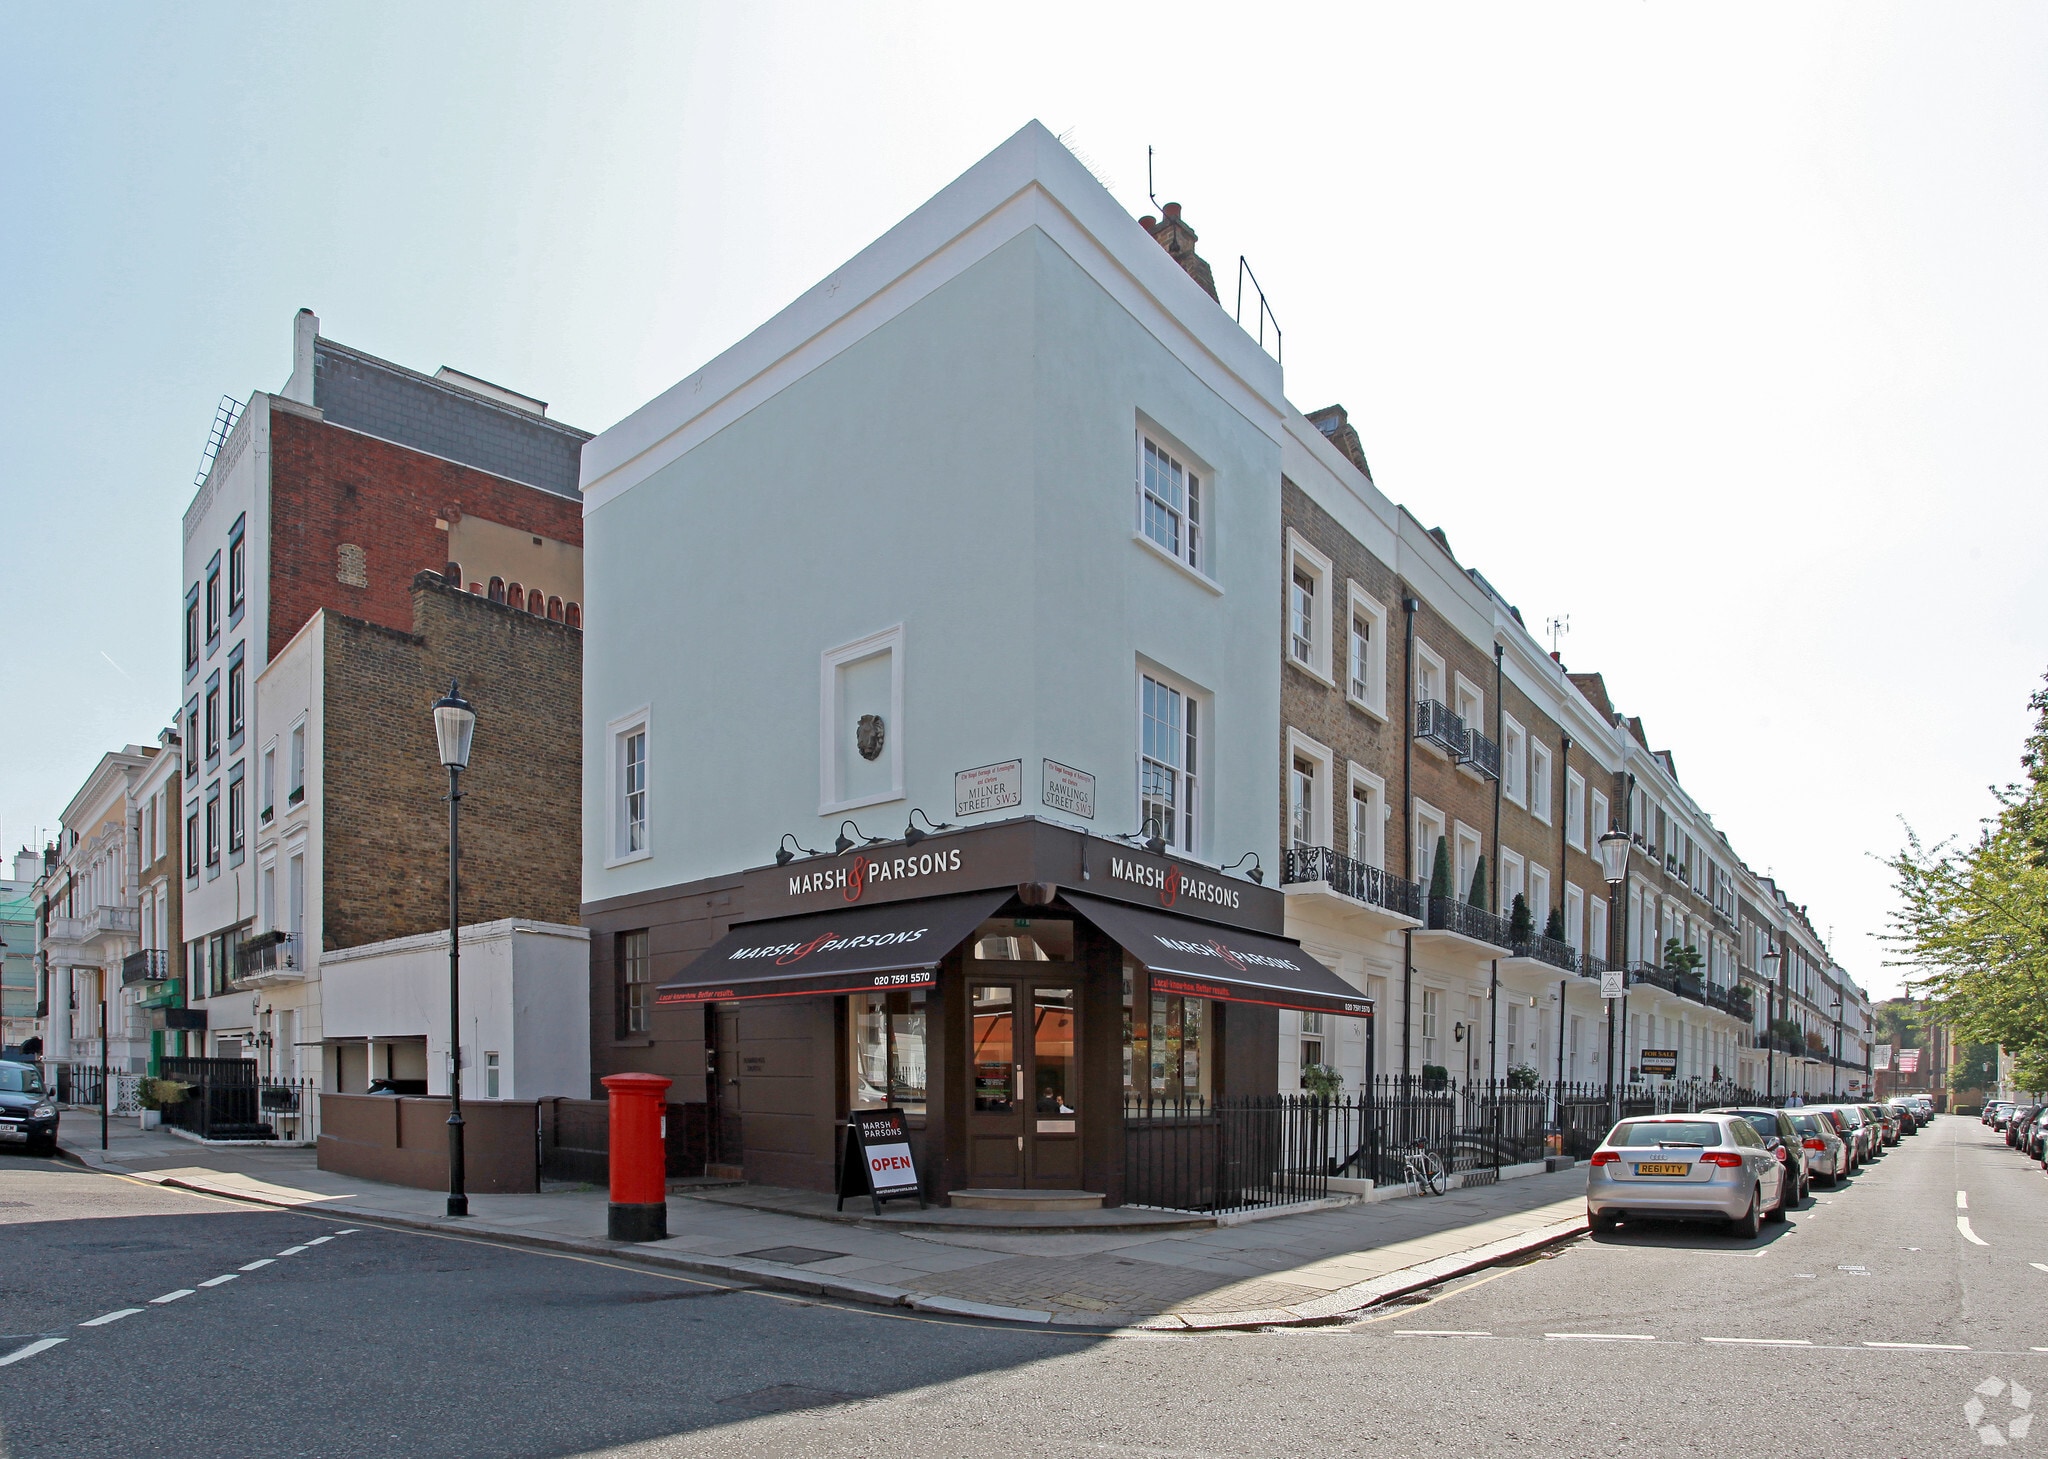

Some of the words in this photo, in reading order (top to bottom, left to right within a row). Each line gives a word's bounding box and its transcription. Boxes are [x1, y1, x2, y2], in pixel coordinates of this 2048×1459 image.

[969, 783, 1006, 799] MILNER
[1050, 780, 1089, 803] RAWLINGS
[789, 868, 847, 896] MARSH
[843, 856, 870, 902] &
[868, 849, 961, 883] PARSONS
[1112, 857, 1164, 890] MARSH
[1161, 864, 1184, 907] &
[1180, 876, 1240, 909] PARSONS
[728, 942, 801, 960] MARSH
[775, 932, 840, 966] &
[817, 928, 928, 953] PARSONS
[1153, 934, 1223, 958] MARSH
[1208, 939, 1247, 971] &
[1229, 950, 1301, 971] PARSONS
[874, 976, 889, 985] 020
[890, 974, 908, 984] 7591
[910, 972, 930, 983] 5570
[862, 1121, 891, 1130] MARSH
[864, 1128, 902, 1138] PARSONS
[871, 1156, 911, 1172] OPEN
[1641, 1164, 1663, 1173] RE61
[1664, 1164, 1683, 1173] VTY
